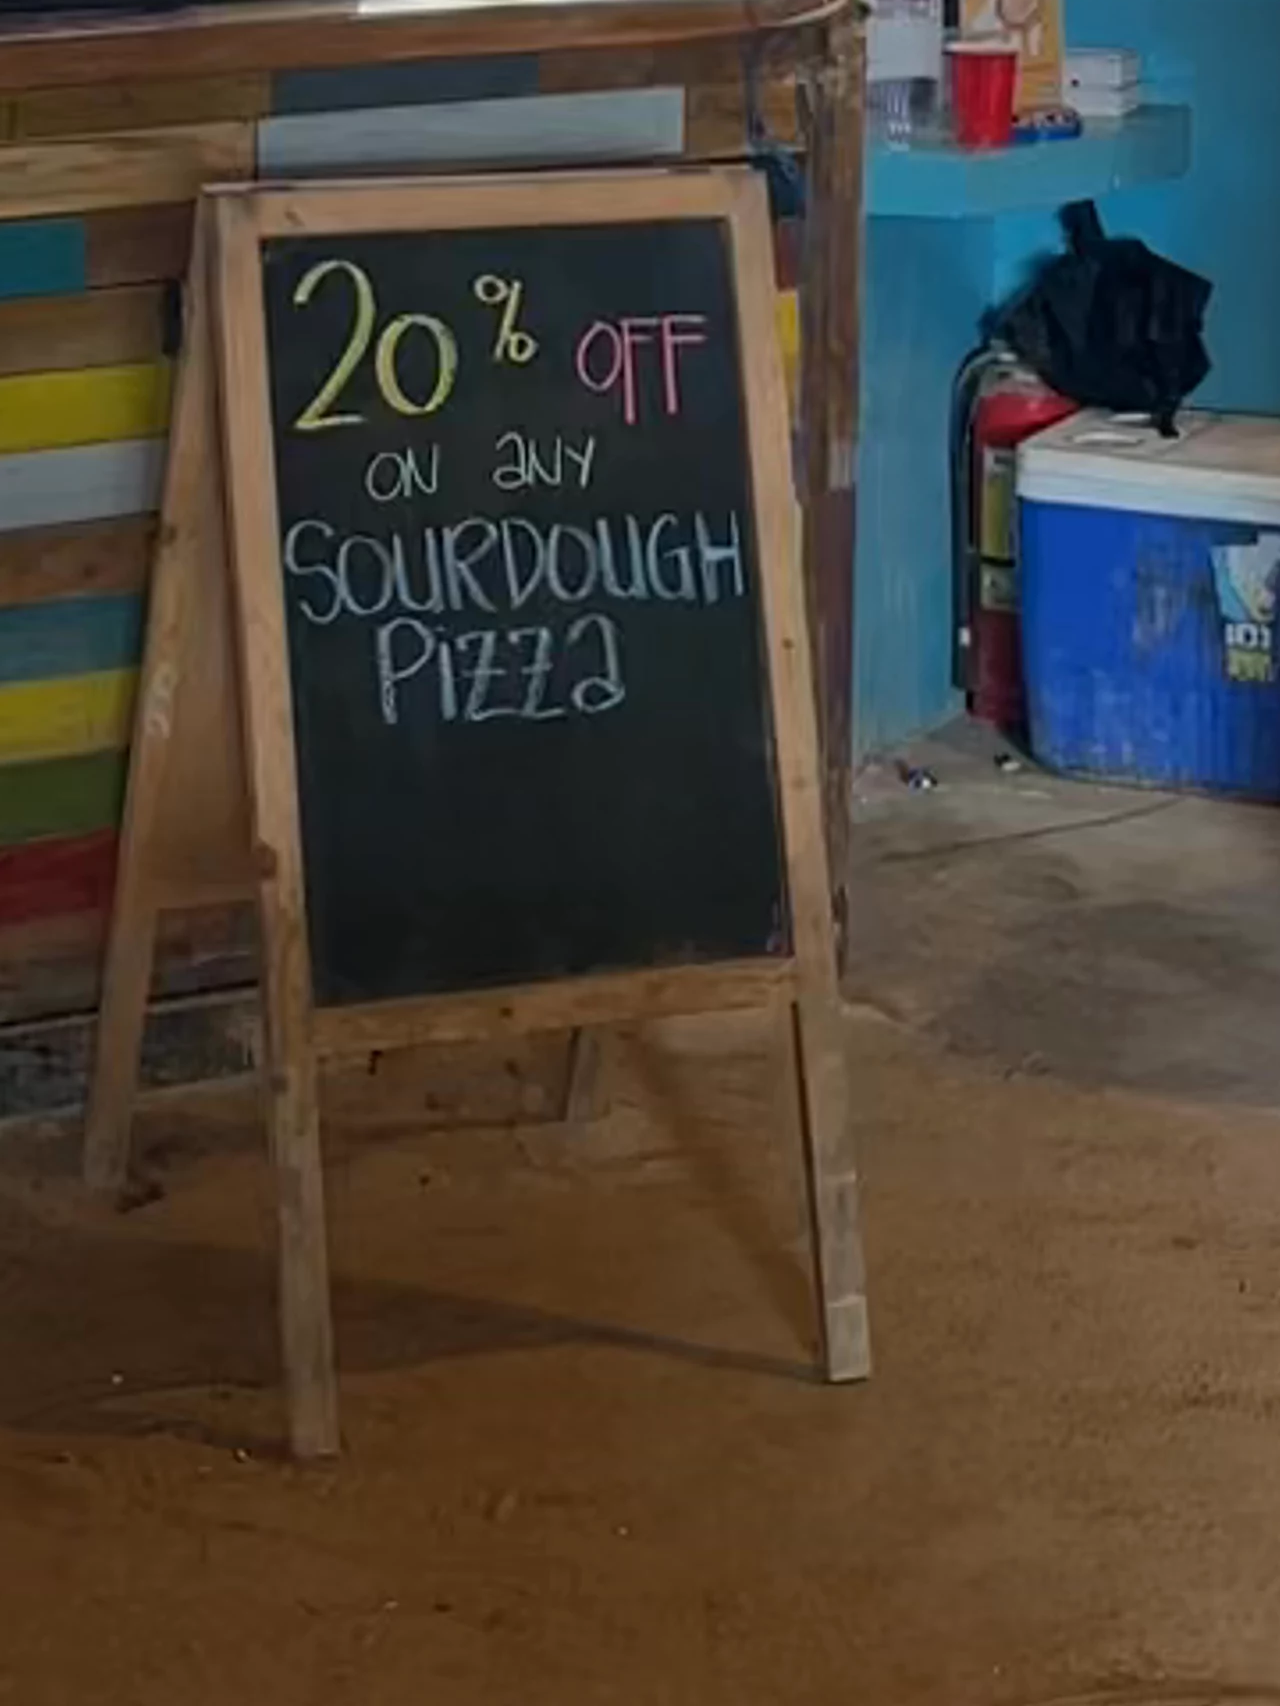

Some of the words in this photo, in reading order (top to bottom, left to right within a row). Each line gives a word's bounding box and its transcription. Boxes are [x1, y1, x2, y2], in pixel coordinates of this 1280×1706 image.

[576, 314, 708, 425] OFF
[364, 444, 439, 501] ON
[284, 510, 744, 625] SOURDOUGH
